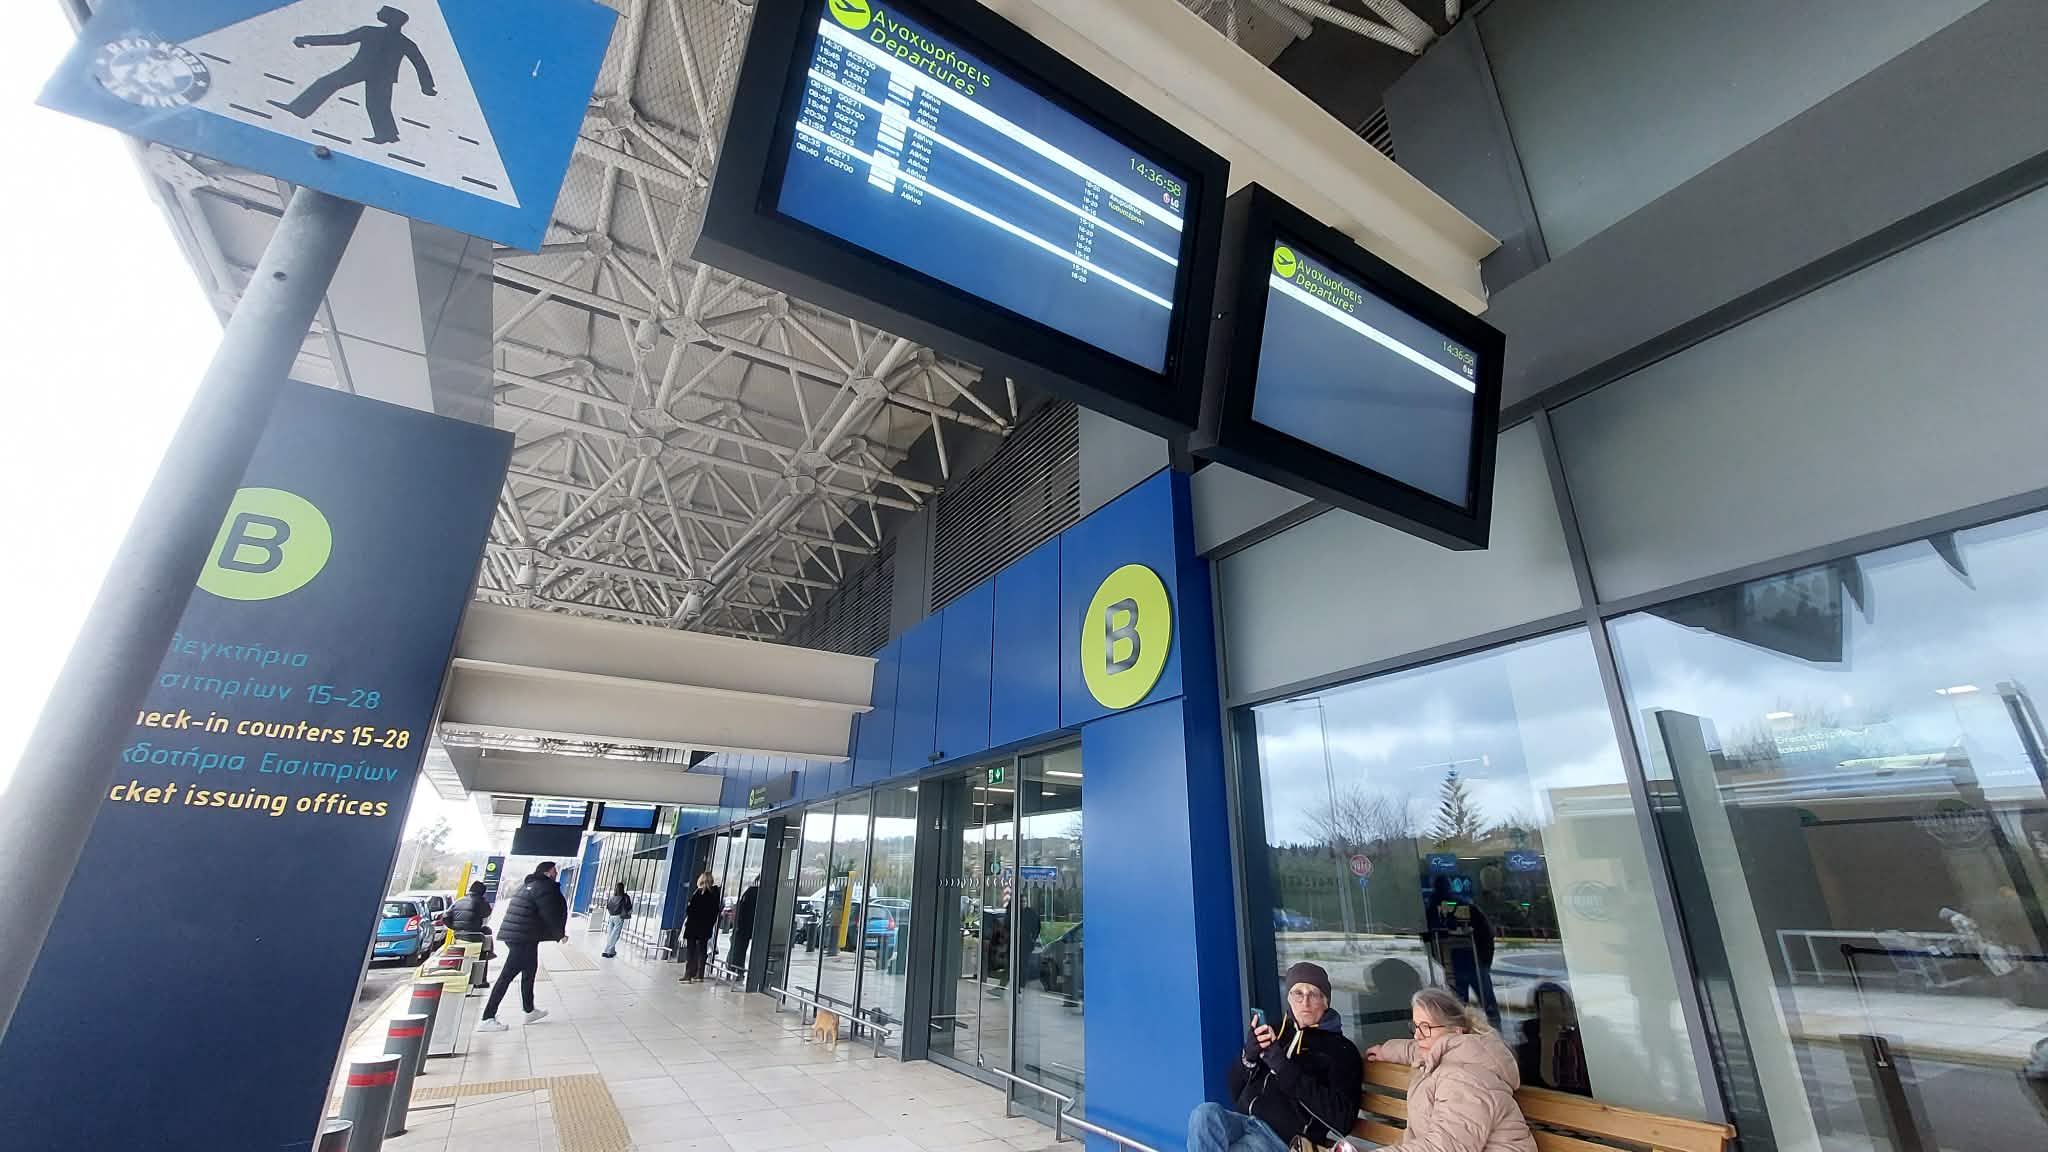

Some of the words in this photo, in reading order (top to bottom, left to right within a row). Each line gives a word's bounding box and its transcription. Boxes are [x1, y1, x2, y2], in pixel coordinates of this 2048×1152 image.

[870, 28, 976, 95] Departures
[873, 10, 991, 87] Αναχωρήσεις
[1130, 158, 1182, 197] 14:36:58
[1170, 197, 1180, 209] LG
[1296, 259, 1363, 305] Αναχωρήσεις
[1296, 274, 1355, 313] Departures
[218, 511, 291, 574] B
[1105, 597, 1141, 676] B
[160, 673, 292, 699] σιτηρίων
[307, 684, 381, 710] 15-28
[136, 708, 229, 733] eck-in
[236, 720, 347, 745] counters
[351, 726, 411, 750] 15-28
[259, 752, 399, 784] Εισιτηρίων
[109, 780, 177, 804] cket
[183, 783, 289, 817] issuing
[295, 792, 389, 818] offices
